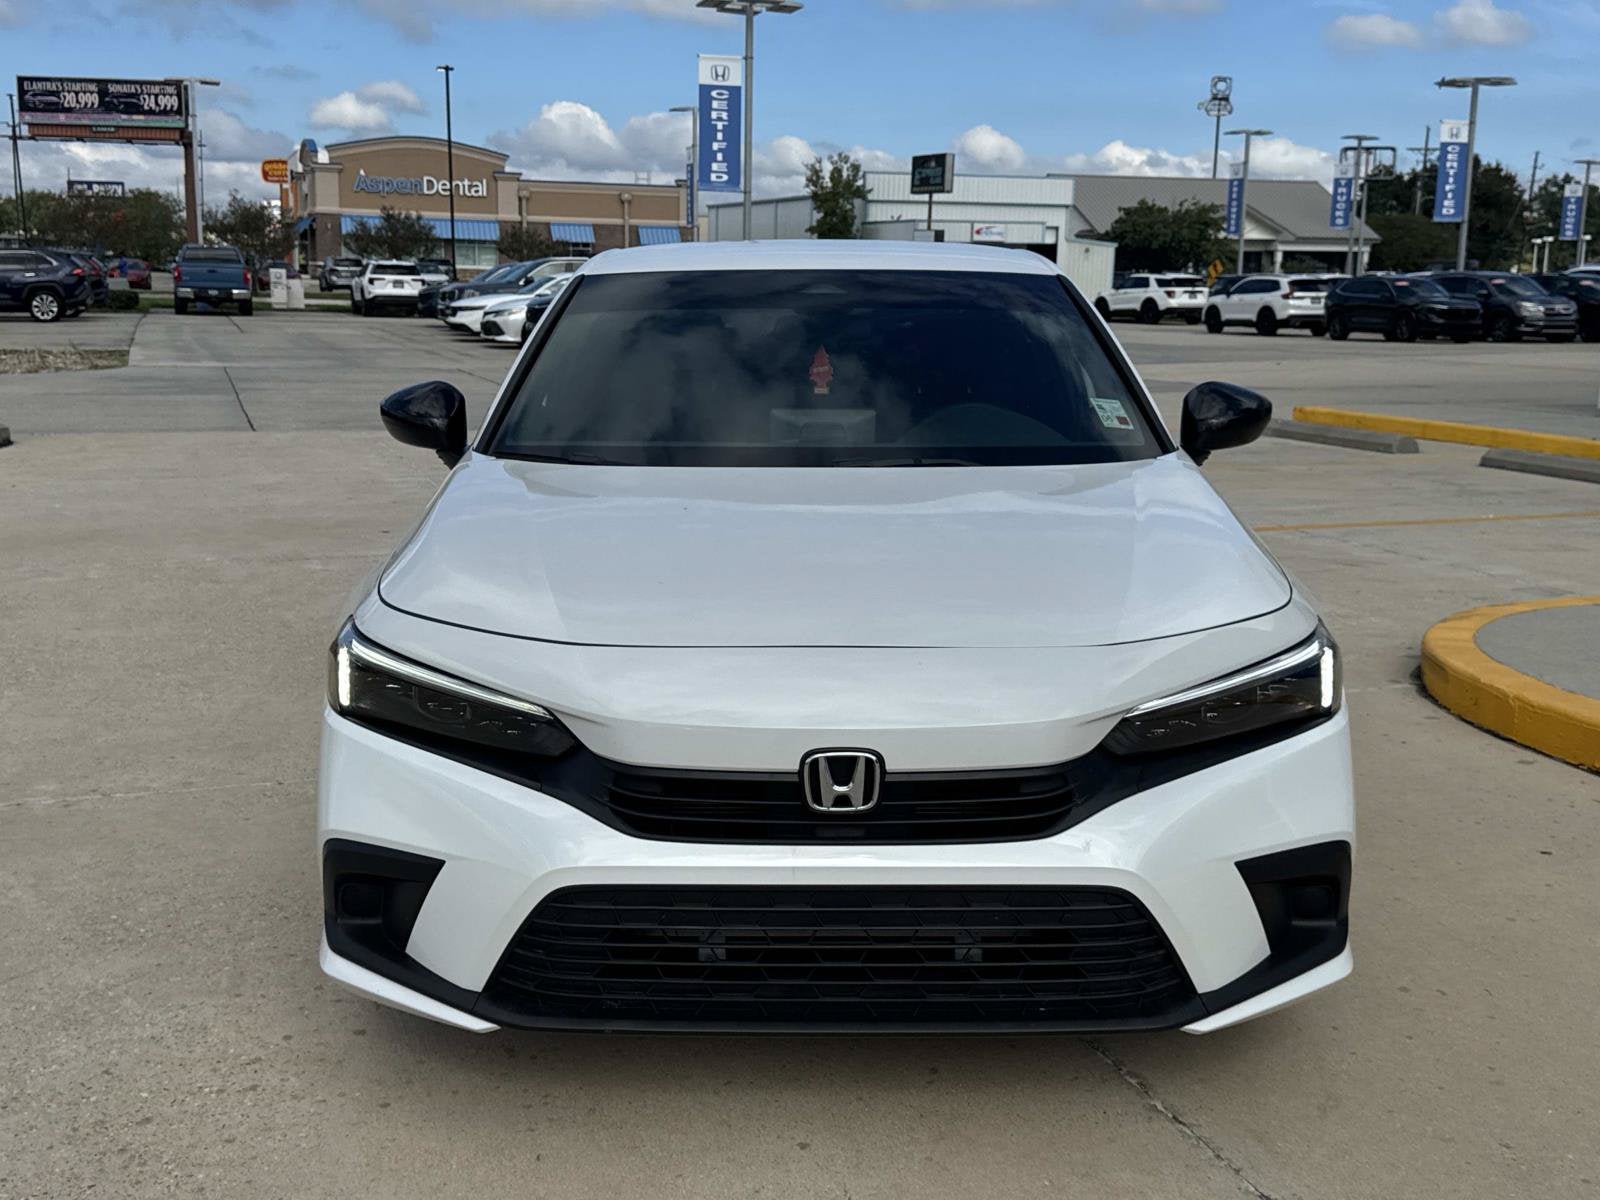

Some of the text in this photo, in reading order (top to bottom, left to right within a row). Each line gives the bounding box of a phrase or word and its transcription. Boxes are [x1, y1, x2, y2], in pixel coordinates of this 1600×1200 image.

[23, 81, 98, 92] ELANTRA'S STARTING
[107, 83, 177, 95] SONATA'S STARTING
[60, 92, 99, 109] $20,999
[140, 94, 178, 112] $24,999
[710, 89, 729, 182] CERTIFIED
[1441, 144, 1460, 215] CERTIFIED
[1335, 179, 1348, 225] TRUCKS
